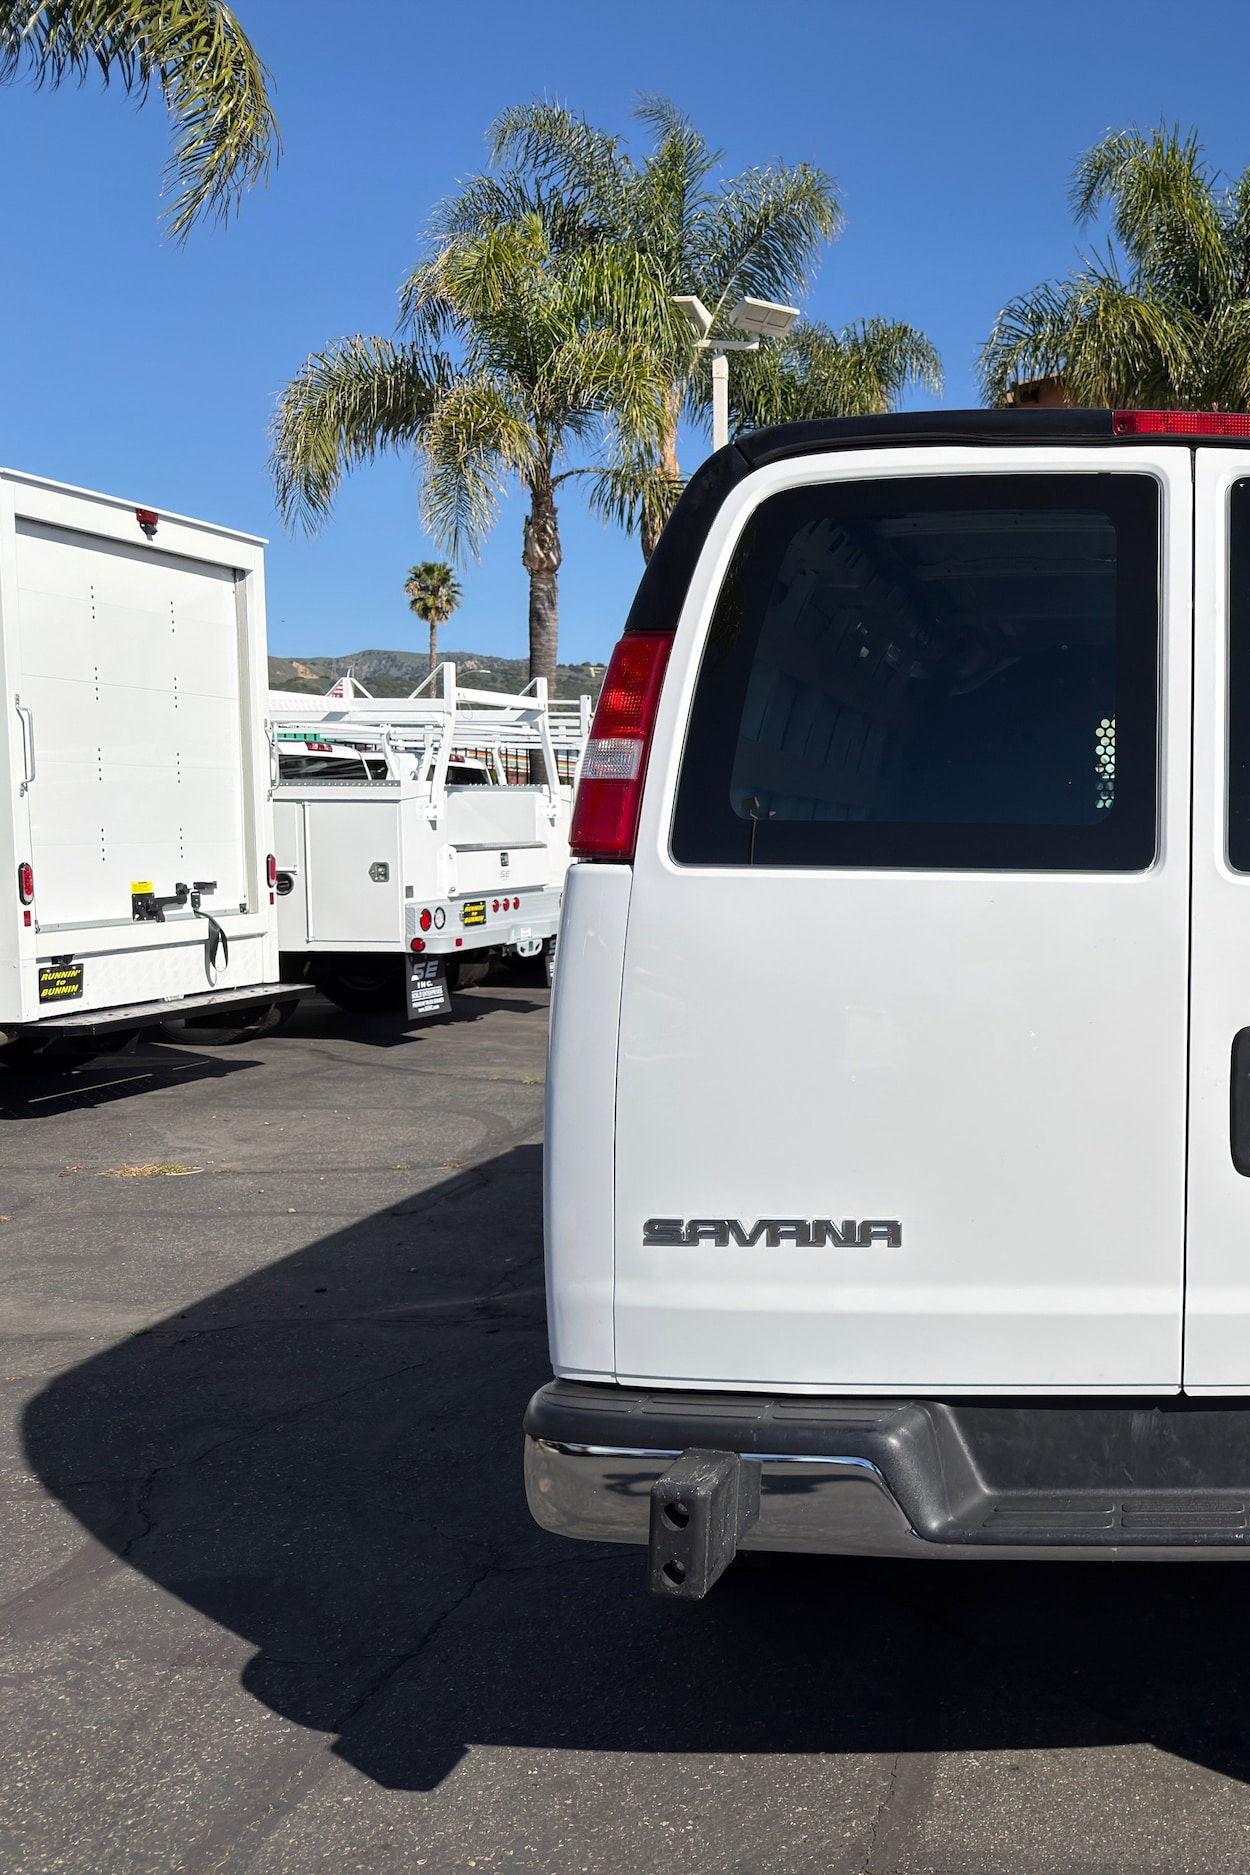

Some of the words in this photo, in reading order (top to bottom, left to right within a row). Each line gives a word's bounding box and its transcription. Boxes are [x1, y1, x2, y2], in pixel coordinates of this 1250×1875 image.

[41, 969, 81, 981] RUNNIN'
[411, 960, 439, 981] SE
[41, 984, 79, 997] BUNNIN
[642, 1218, 903, 1248] SAVANA
